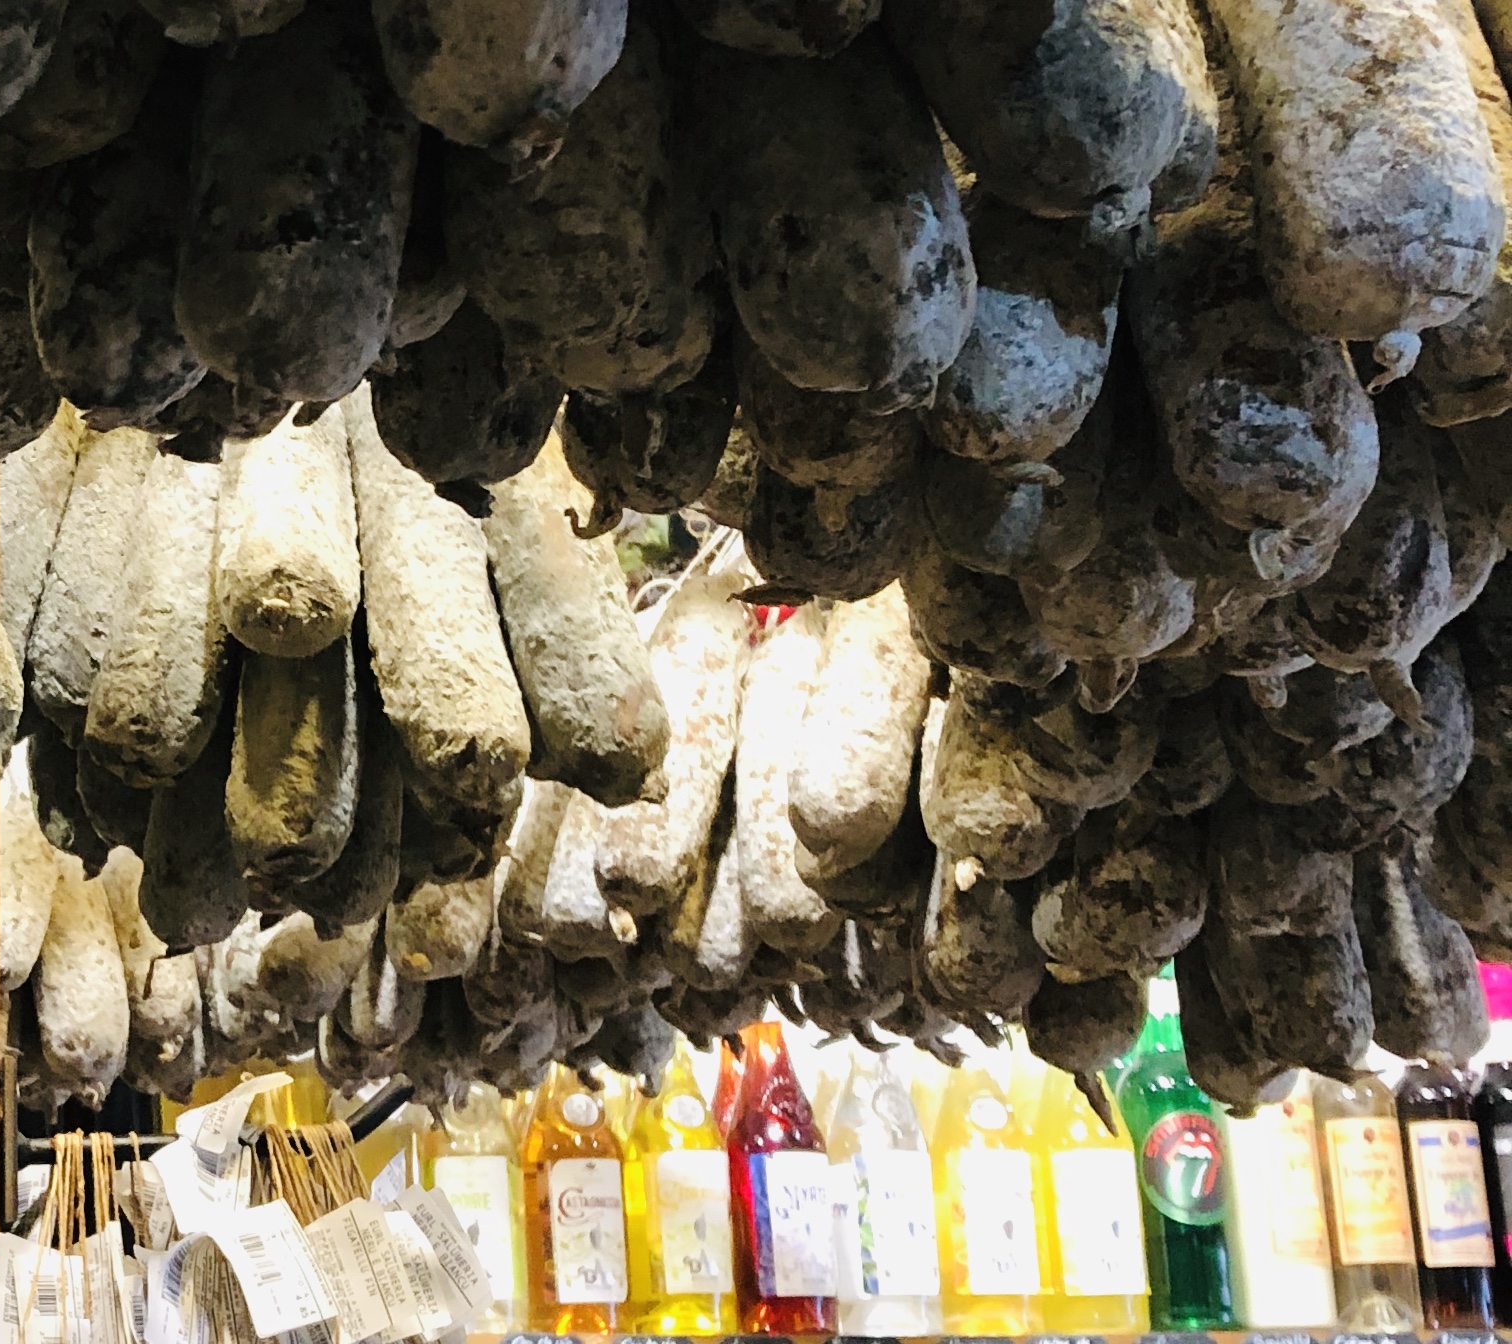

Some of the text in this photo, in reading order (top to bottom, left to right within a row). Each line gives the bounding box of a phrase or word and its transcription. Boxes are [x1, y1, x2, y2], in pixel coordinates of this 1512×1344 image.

[341, 1216, 378, 1298] FIGATELLU FIN
[361, 1227, 377, 1254] NERU
[376, 1268, 396, 1308] BIANCU
[369, 1219, 407, 1305] EURL SALUMERIA
[411, 1254, 439, 1316] SALUMERIA
[417, 1203, 479, 1286] EURL SALUMERIA
